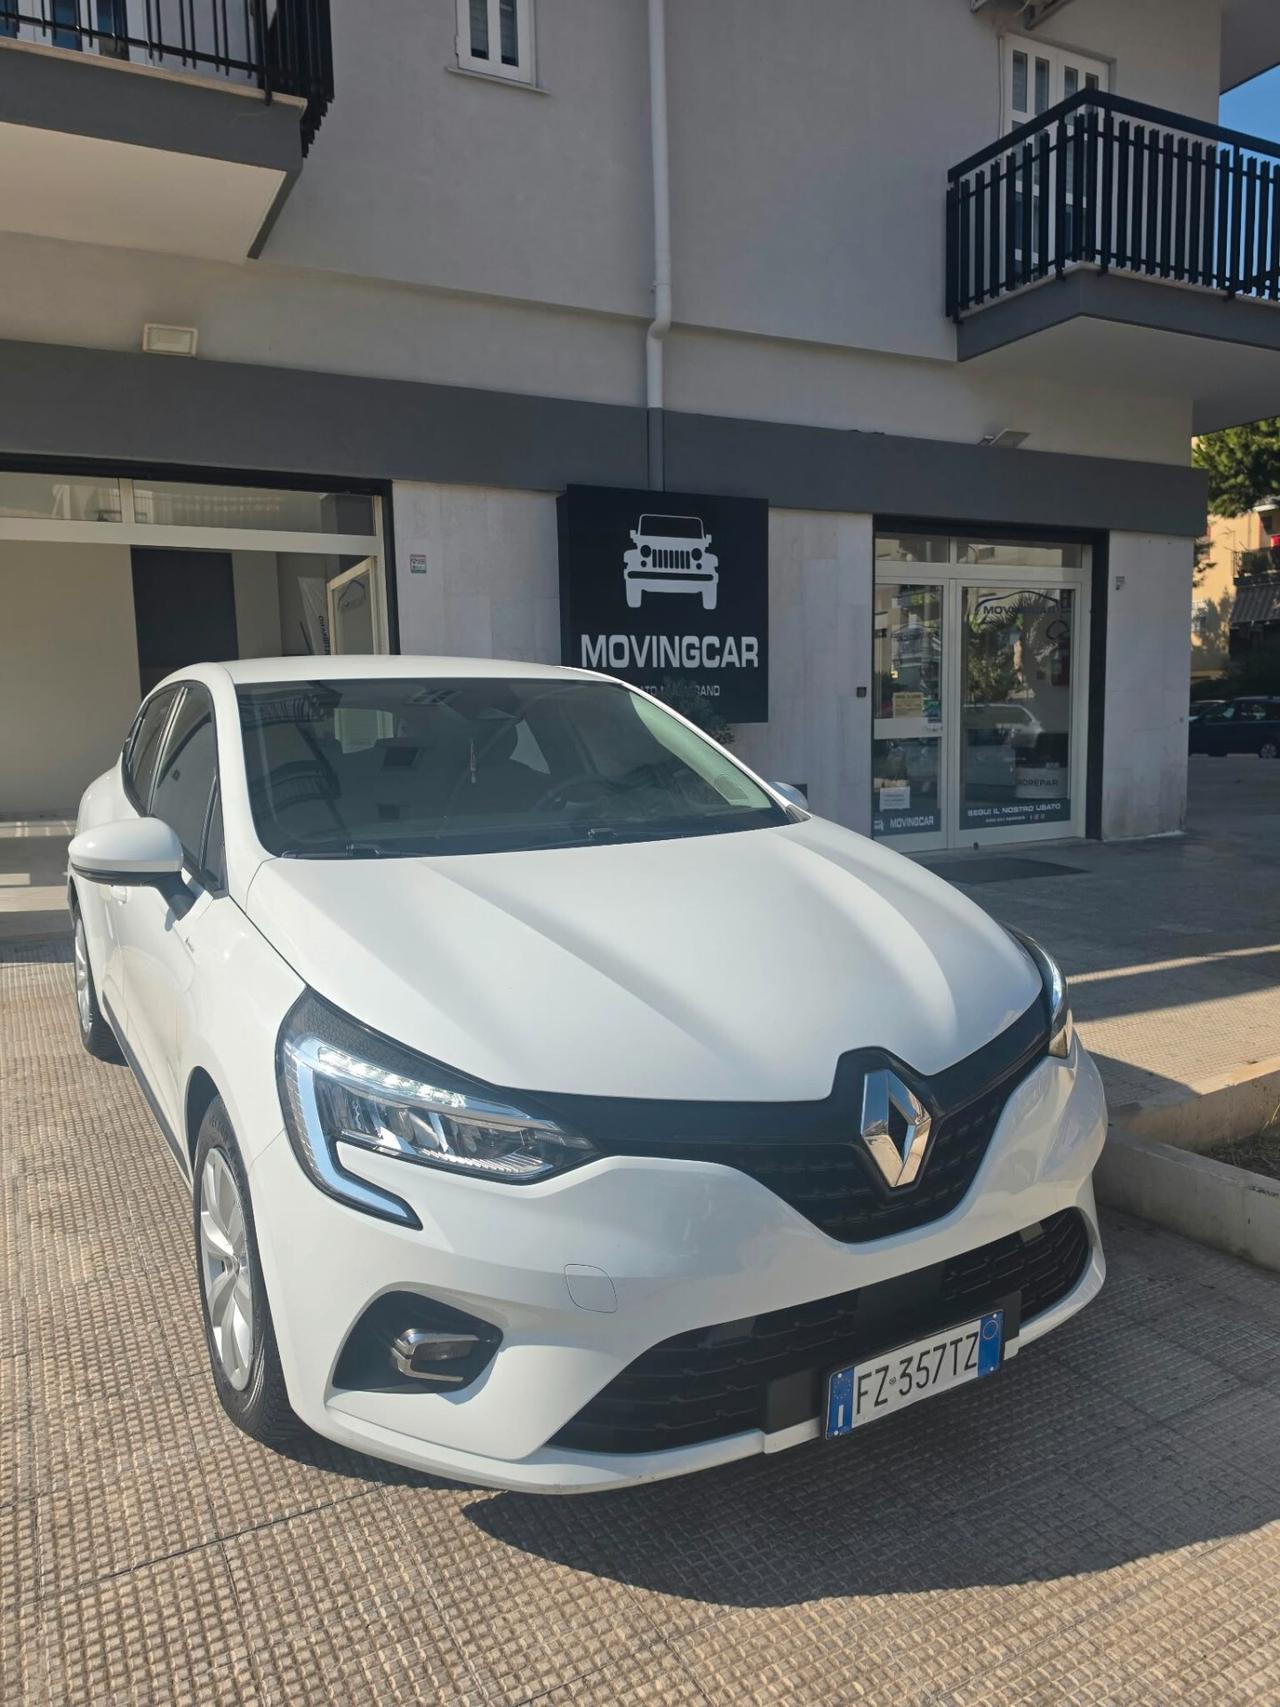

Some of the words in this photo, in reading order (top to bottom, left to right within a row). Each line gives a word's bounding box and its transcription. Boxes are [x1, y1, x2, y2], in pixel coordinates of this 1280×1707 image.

[580, 634, 759, 668] MOVINGCAR
[967, 808, 992, 817] SEGUI
[1001, 805, 1034, 814] NOSTRO
[1036, 803, 1061, 811] USATO
[889, 816, 934, 829] MOVINGCAR
[856, 1364, 890, 1414] FZ
[898, 1331, 979, 1396] 357TZ
